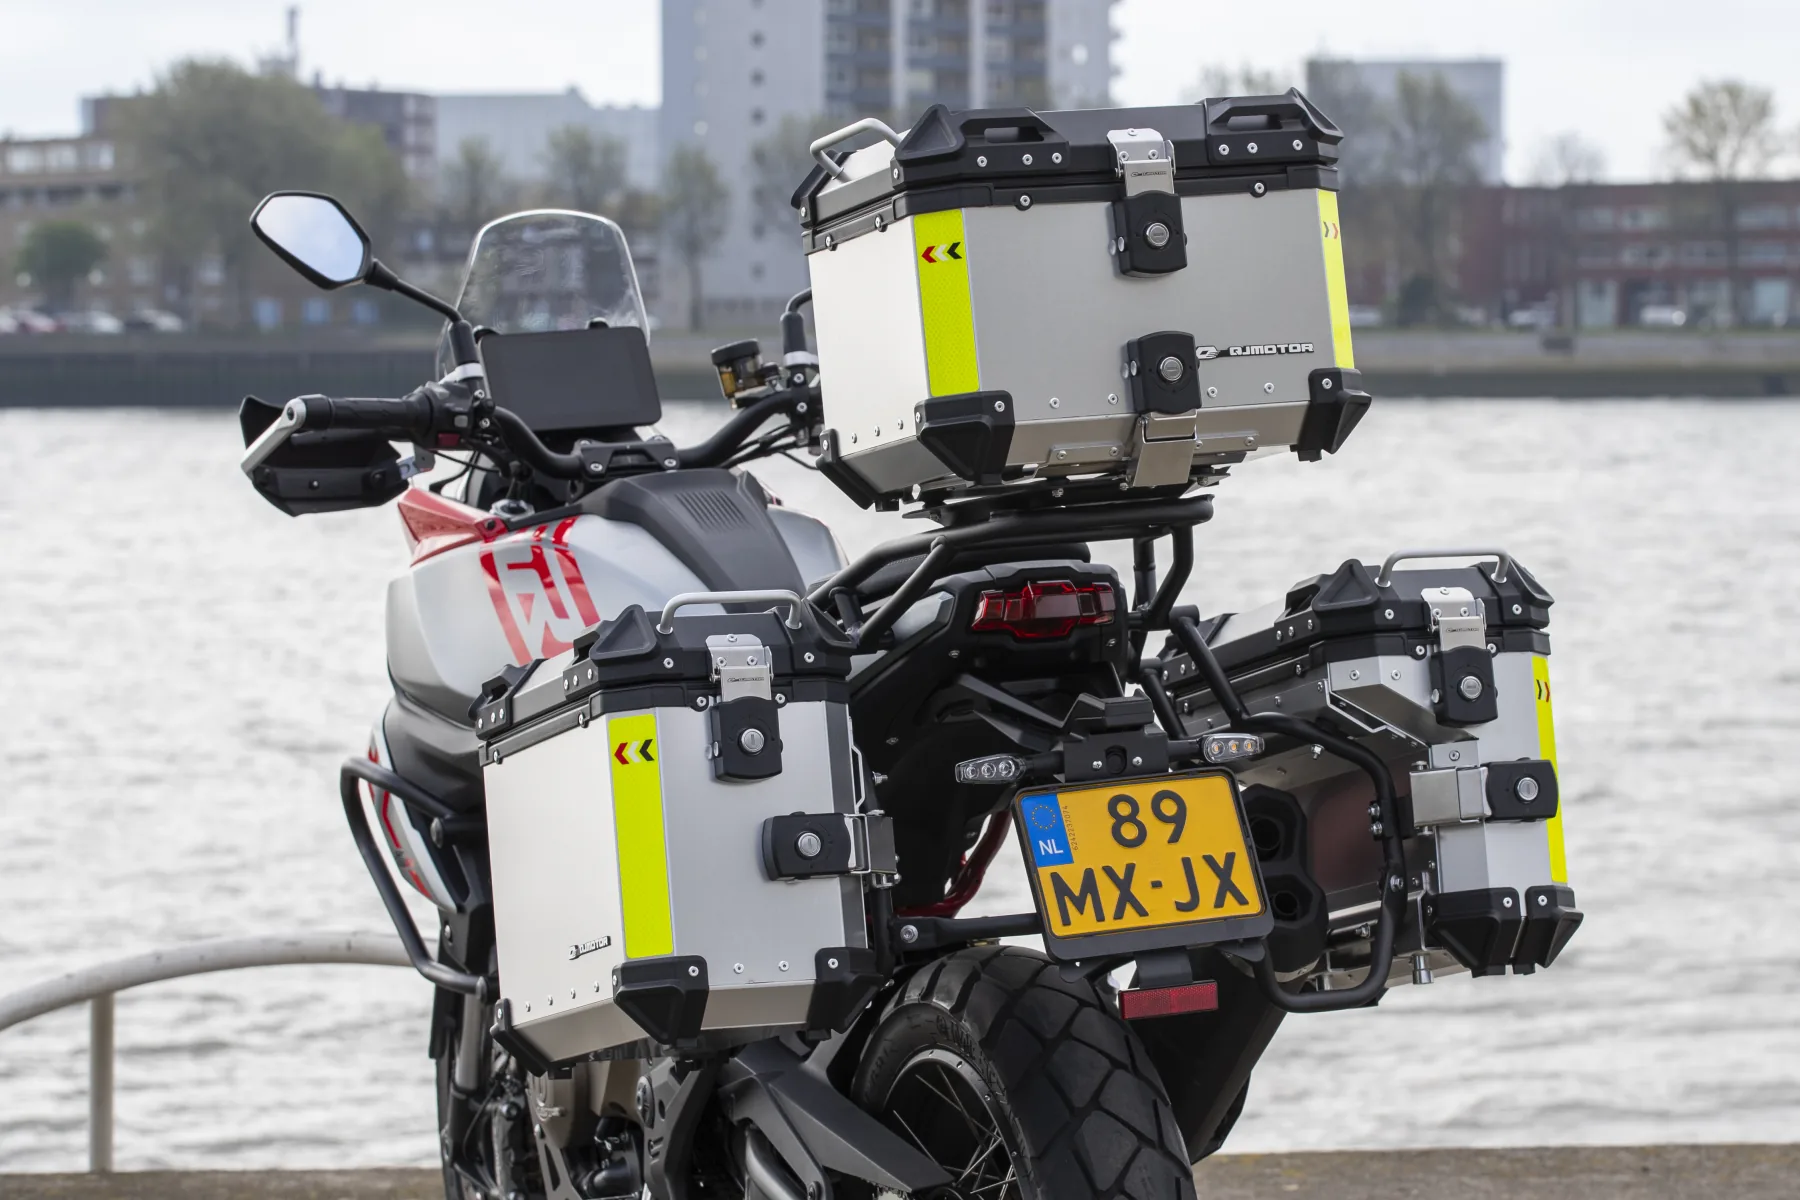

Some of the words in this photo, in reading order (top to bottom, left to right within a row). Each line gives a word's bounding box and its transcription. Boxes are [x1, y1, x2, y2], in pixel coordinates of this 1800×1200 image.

[1228, 342, 1314, 356] QJMOTOR
[1108, 790, 1187, 848] 89
[1038, 839, 1064, 856] NL
[1050, 852, 1249, 926] MX-JX
